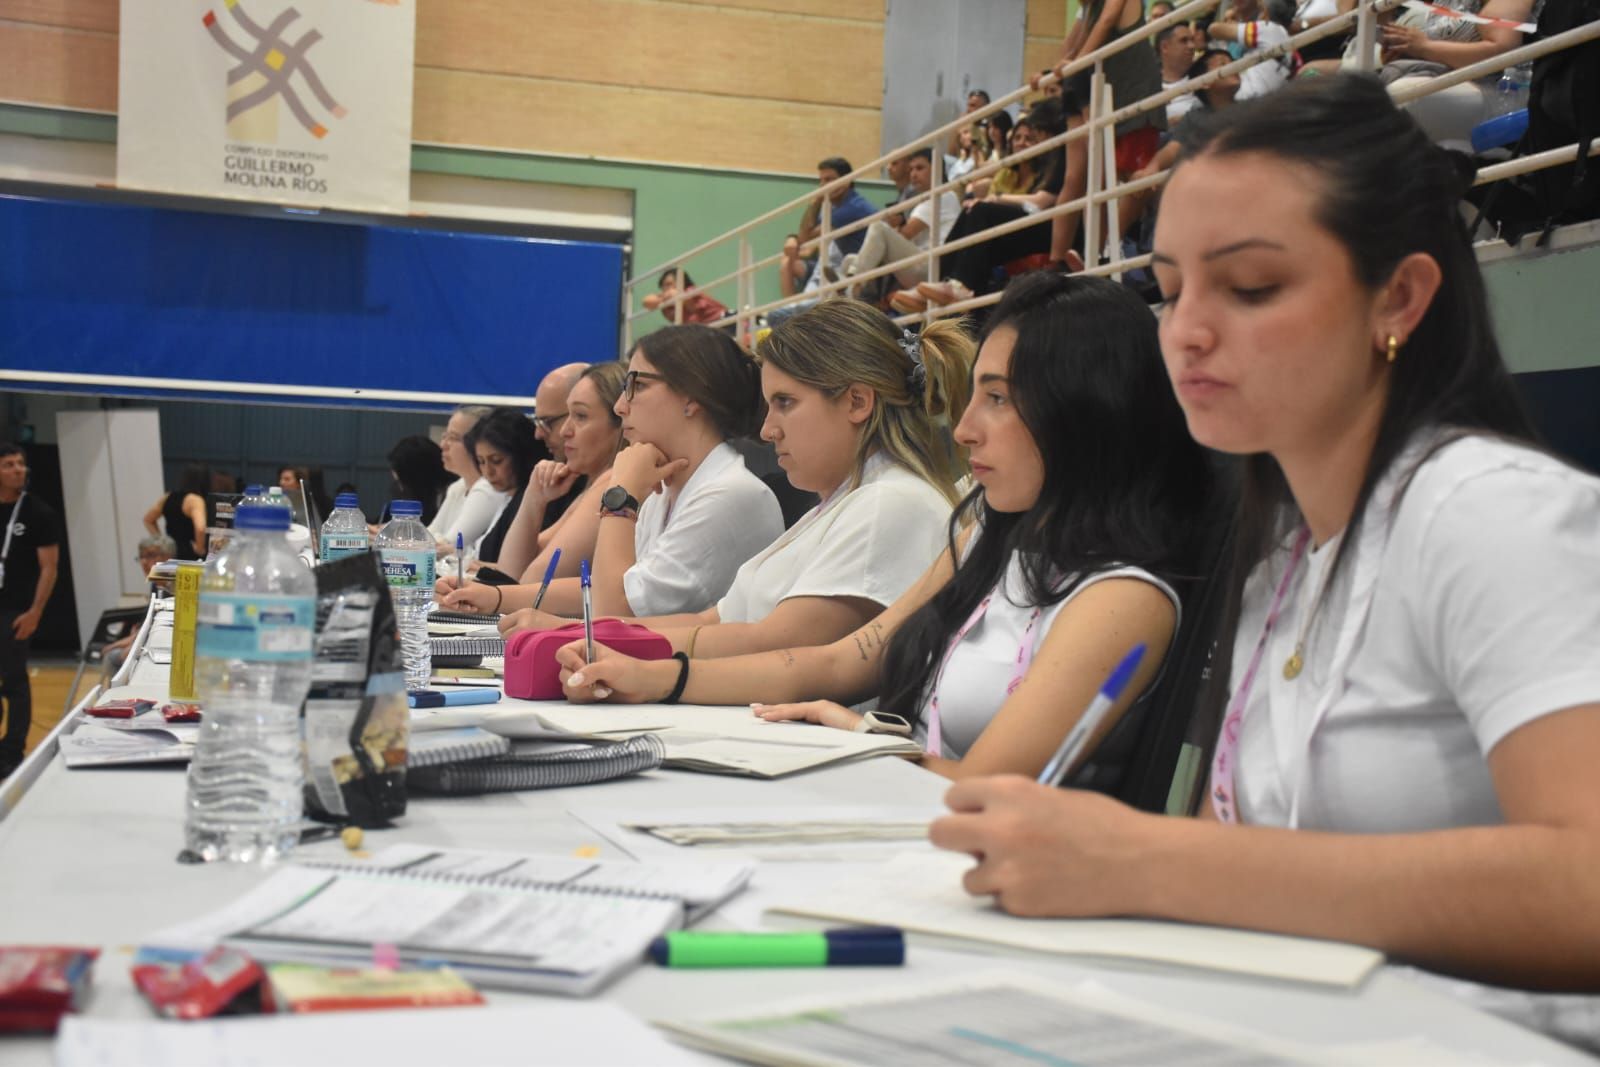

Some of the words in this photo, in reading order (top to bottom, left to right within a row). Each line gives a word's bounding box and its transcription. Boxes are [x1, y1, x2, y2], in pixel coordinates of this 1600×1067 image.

[224, 155, 315, 177] GUILLERMO
[275, 149, 329, 161] DEPORTIVO
[223, 171, 287, 189] MOLINA
[292, 176, 328, 194] RÍOS
